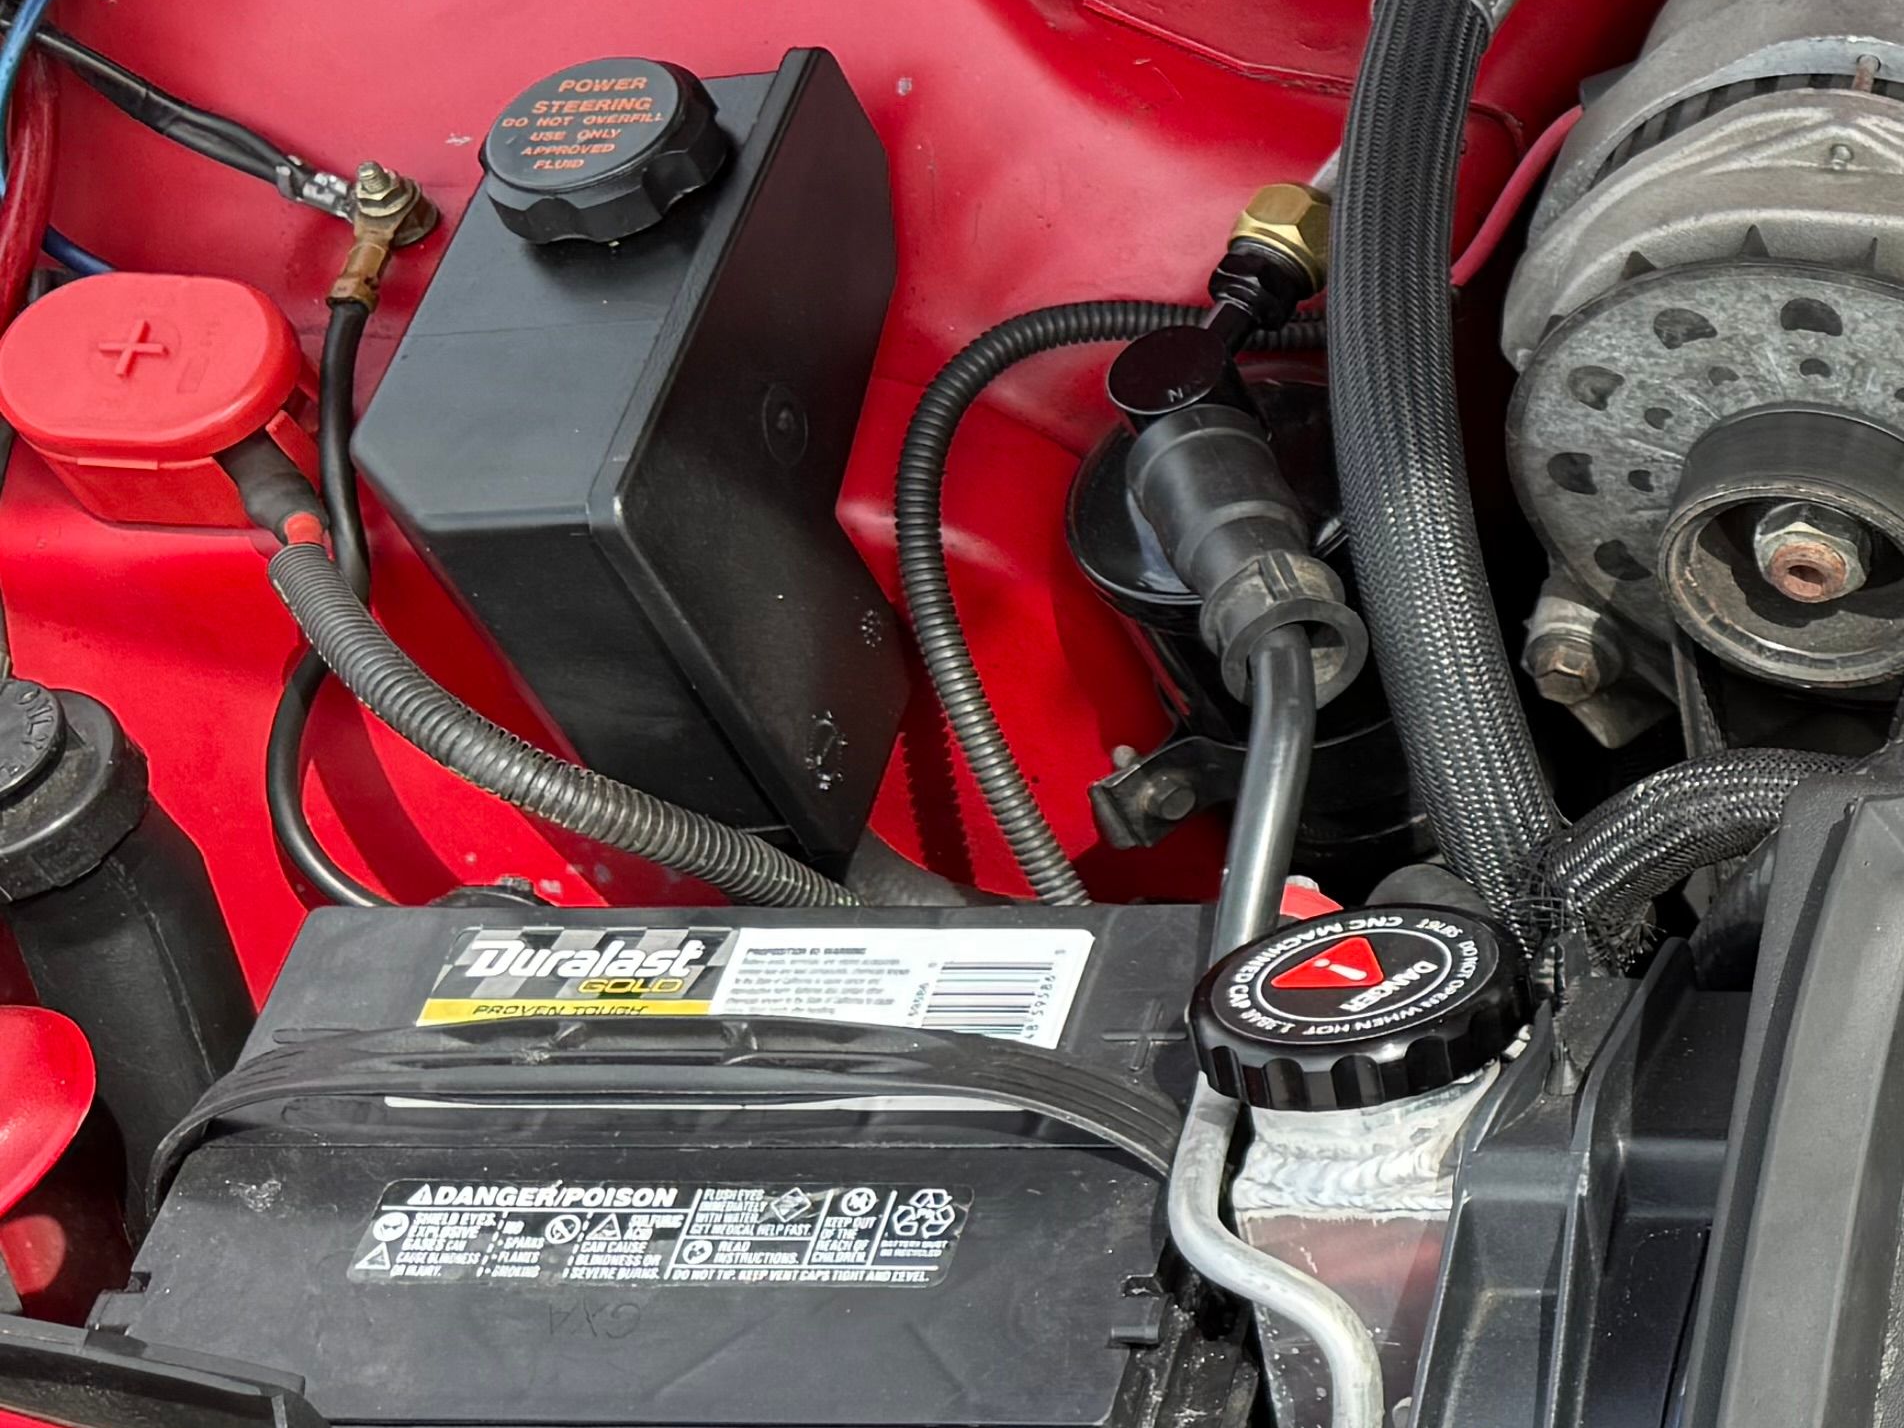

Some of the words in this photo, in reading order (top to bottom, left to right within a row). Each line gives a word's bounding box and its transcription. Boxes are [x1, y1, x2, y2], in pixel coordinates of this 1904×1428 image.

[558, 76, 649, 93] POWER
[532, 97, 653, 115] STEERING
[501, 117, 529, 128] DO
[536, 116, 574, 127] NOT
[583, 113, 664, 126] OVERFILL
[529, 131, 567, 142] USE
[577, 128, 622, 142] ONLY
[521, 143, 616, 156] APPROVED
[533, 159, 585, 170] FLUID
[1348, 916, 1404, 930] CNC
[464, 939, 705, 978] Duralast
[1232, 921, 1345, 992] MACHINED
[577, 977, 687, 995] GOLD
[1339, 960, 1439, 1013] DANGER
[472, 1004, 567, 1016] PROVEN
[570, 1005, 650, 1017] TOUGH
[1354, 1005, 1423, 1032] WHEN
[1302, 1022, 1352, 1036] HOT
[433, 1184, 678, 1208] DANGER/POISON
